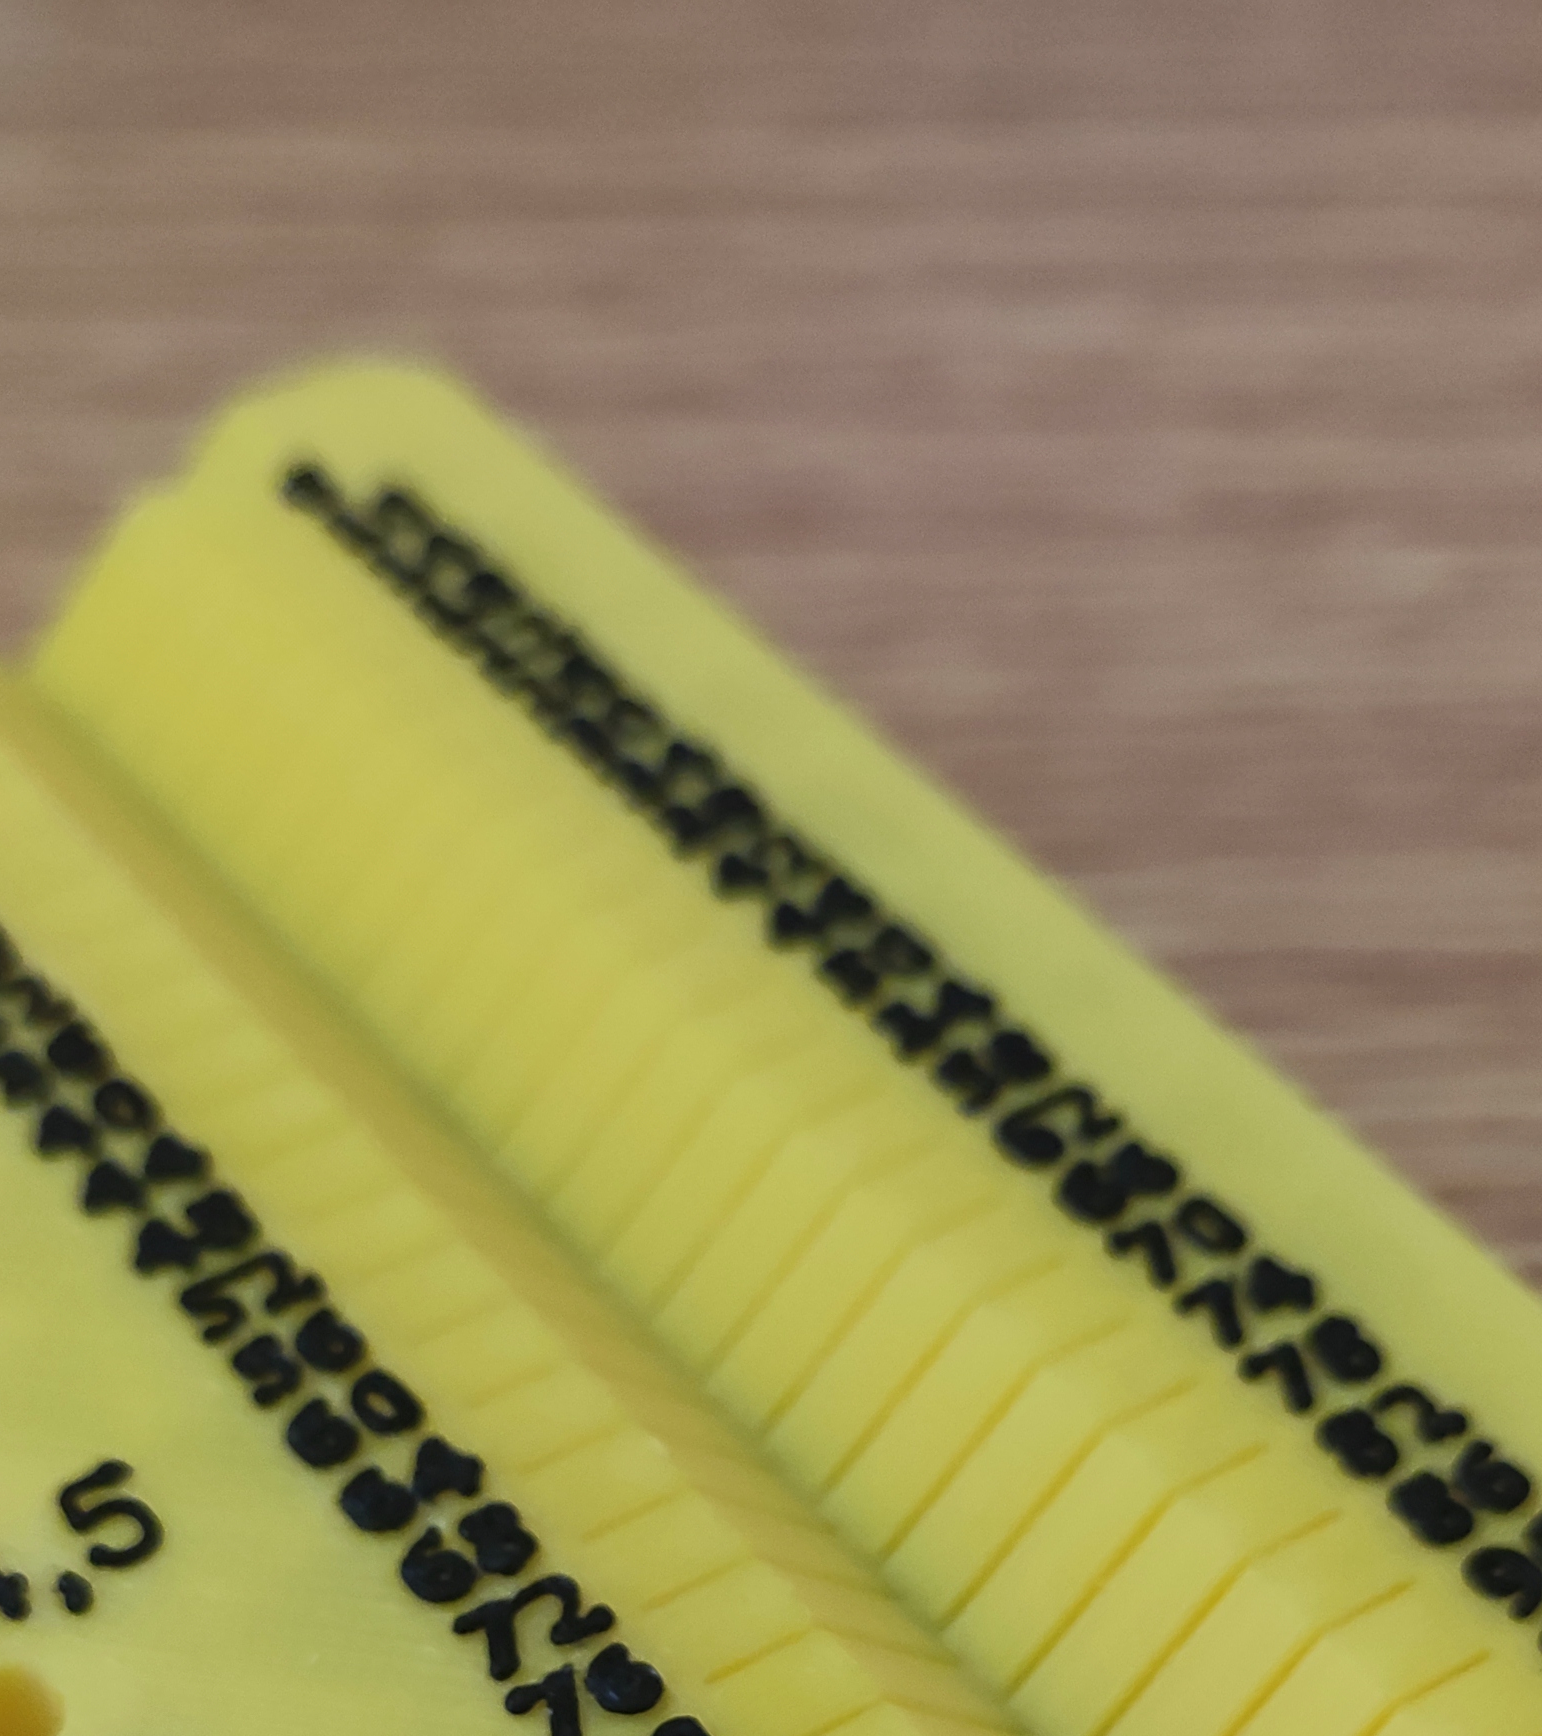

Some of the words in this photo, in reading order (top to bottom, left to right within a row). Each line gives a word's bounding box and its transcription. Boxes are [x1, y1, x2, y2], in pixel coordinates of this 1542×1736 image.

[993, 1085, 1125, 1170] 62
[1105, 1196, 1247, 1290] 70
[180, 1250, 326, 1345] 52
[1172, 1254, 1316, 1351] 74
[232, 1307, 367, 1409] 56
[1238, 1314, 1383, 1414] 78
[286, 1369, 426, 1470] 60
[1313, 1385, 1469, 1482] 82
[340, 1436, 485, 1533] 64
[1385, 1440, 1532, 1552] 86
[401, 1501, 540, 1603] 68
[452, 1572, 616, 1682] 72
